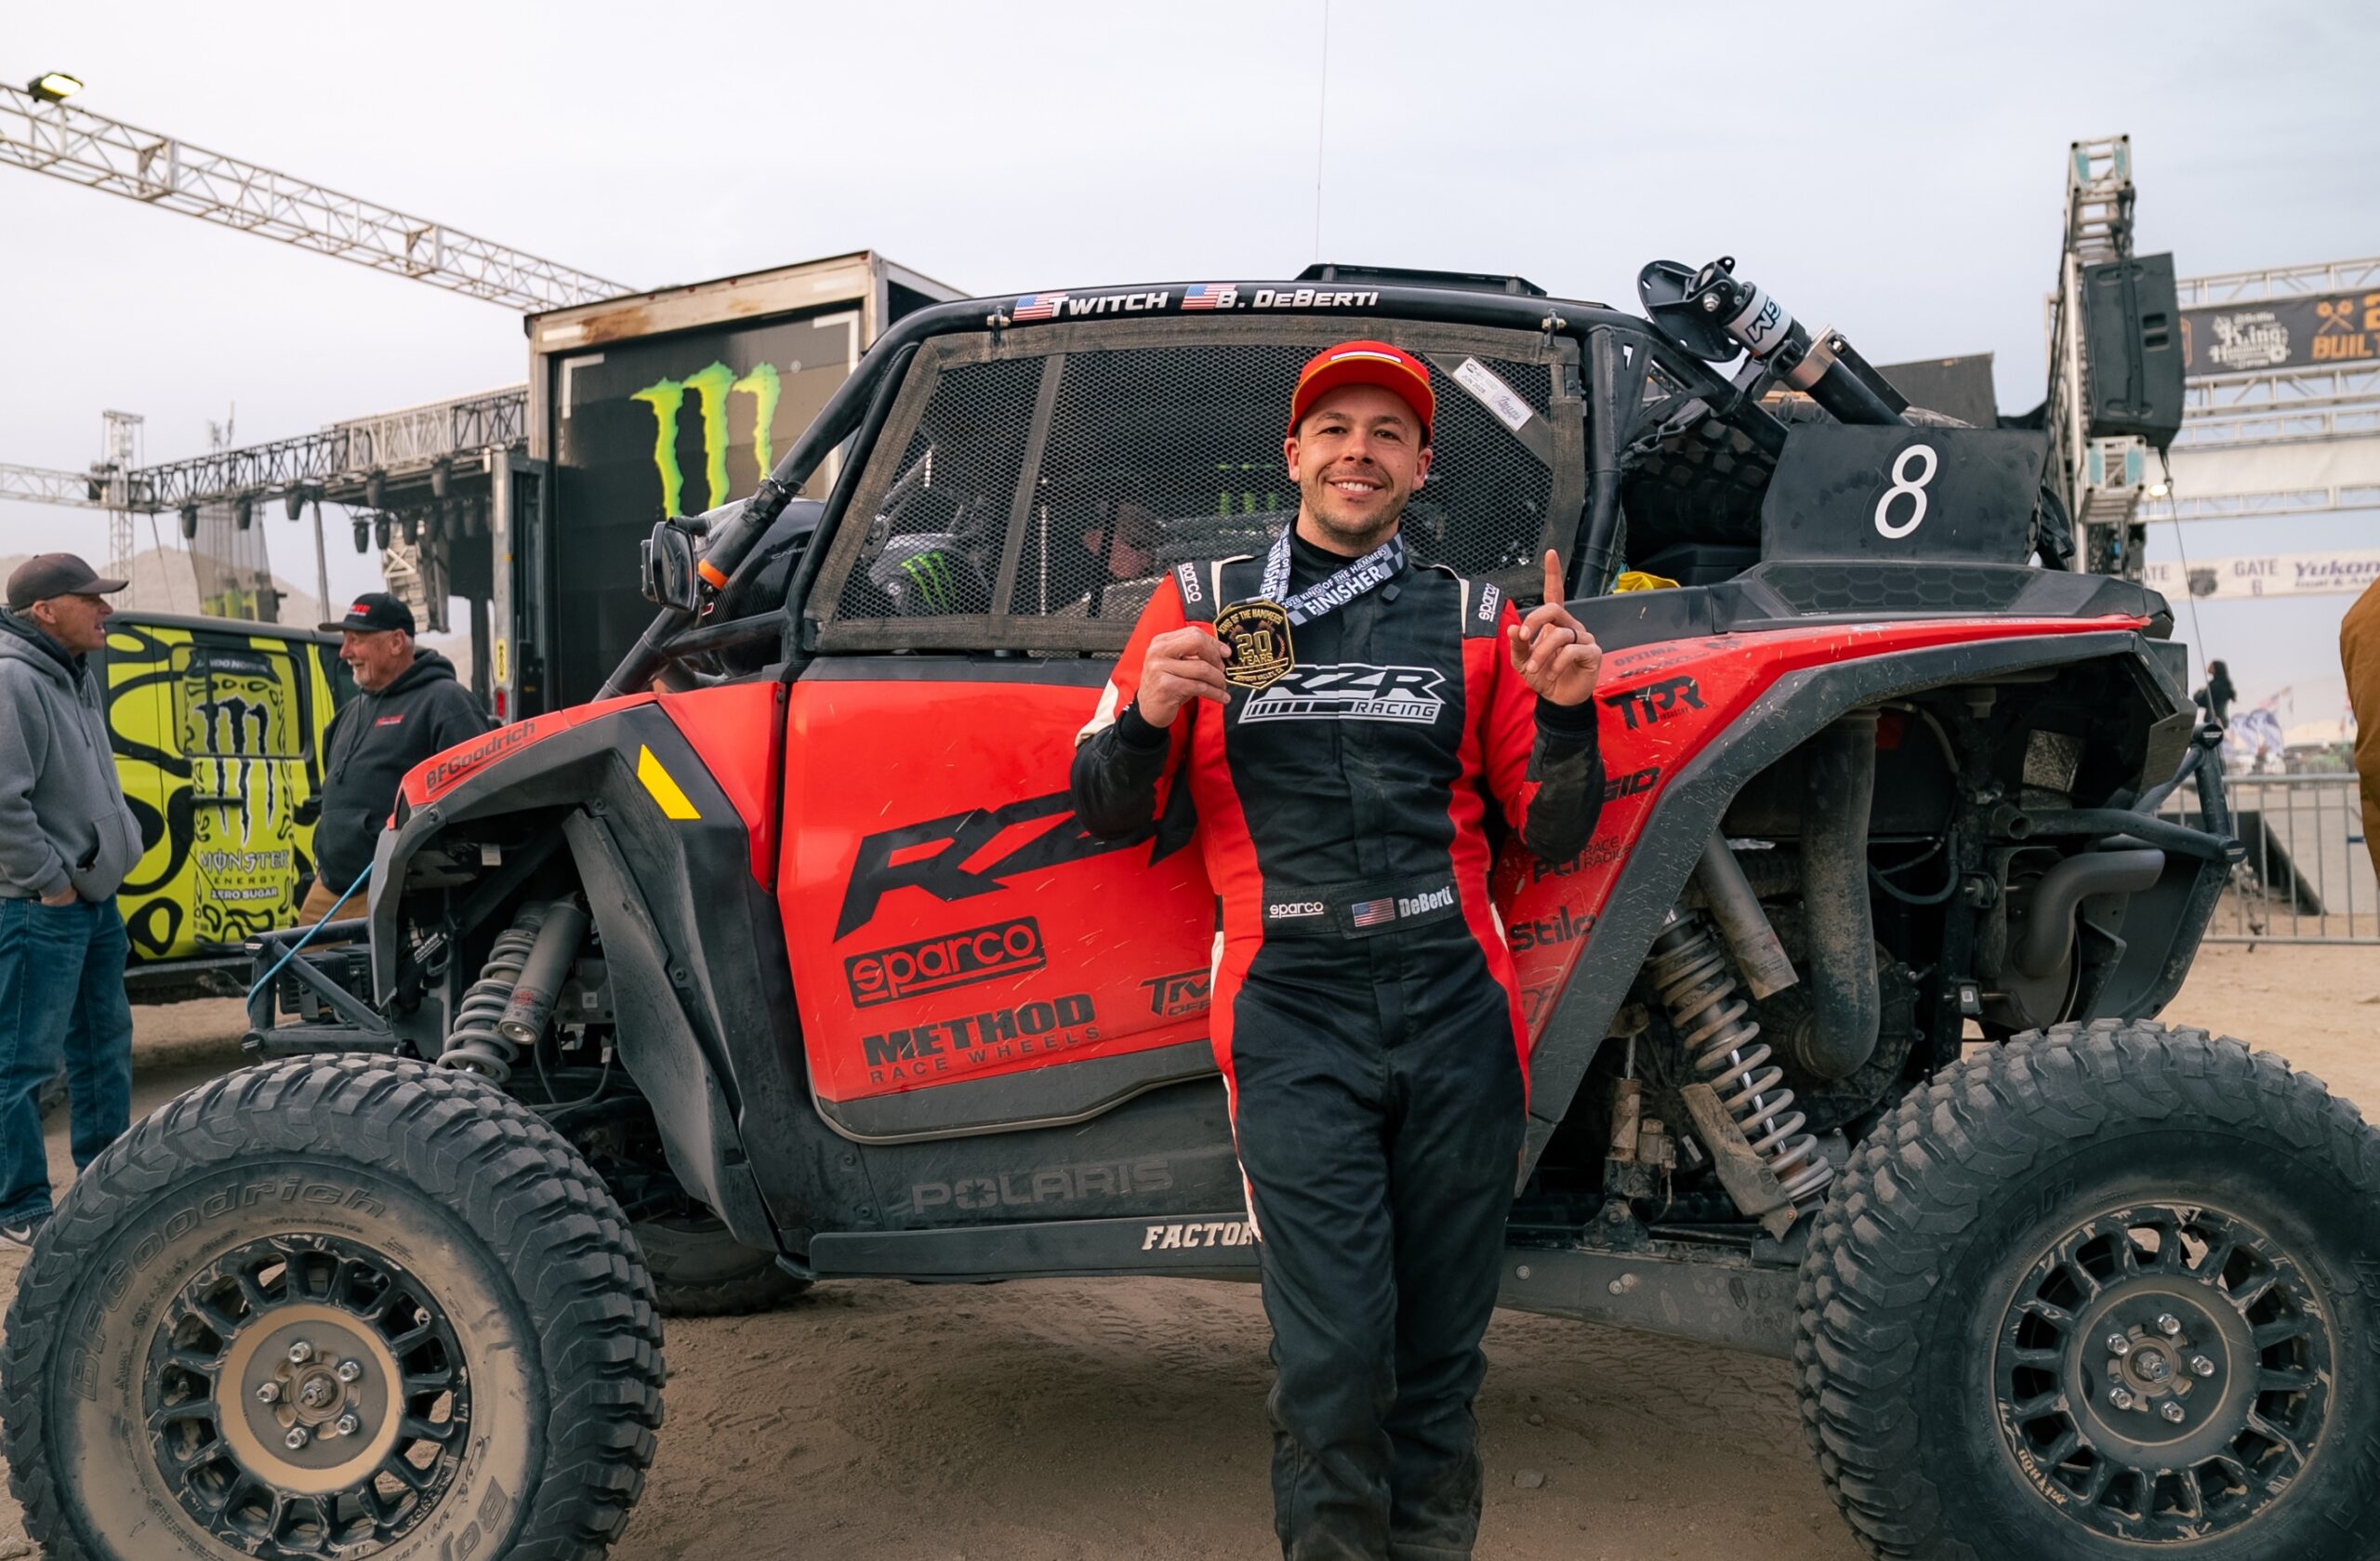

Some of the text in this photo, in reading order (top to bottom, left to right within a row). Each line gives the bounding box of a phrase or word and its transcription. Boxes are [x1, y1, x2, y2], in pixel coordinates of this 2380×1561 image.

[1048, 291, 1169, 318] TWITCH
[1215, 289, 1246, 309] B.
[2312, 334, 2380, 360] BUIL
[1874, 443, 1937, 539] 8
[1300, 587, 1322, 602] KING
[1322, 578, 1334, 590] OF
[1334, 569, 1351, 584] THE
[1350, 548, 1387, 574] HAMMERS
[2145, 564, 2170, 581] ATE
[2234, 560, 2278, 576] GATE
[2294, 560, 2380, 576] Yukon
[1303, 565, 1383, 615] FINISHER
[1478, 582, 1500, 622] sparco
[1239, 609, 1251, 620] THE
[1236, 630, 1272, 658] 20
[1614, 646, 1678, 667] OPTIMA
[1238, 653, 1274, 668] YEARS
[1249, 664, 1445, 704] RZR
[1354, 701, 1436, 718] RACING
[1602, 675, 1709, 730] TPR
[426, 721, 536, 790] BFGoodrich
[1584, 837, 1620, 857] RACE
[210, 886, 278, 901] ZERO SUGAR
[214, 876, 277, 885] ENERGY
[1269, 901, 1325, 919] sparco
[1398, 886, 1455, 919] DeBerti
[851, 923, 1040, 1003] sparco
[1168, 1000, 1211, 1016] OFF
[861, 993, 1096, 1069] METHOD
[869, 1025, 1102, 1085] RACE WHEELS
[910, 1160, 1174, 1215] POLARIS
[1141, 1221, 1254, 1251] FACTOR
[69, 1177, 387, 1402] BFGoodrich
